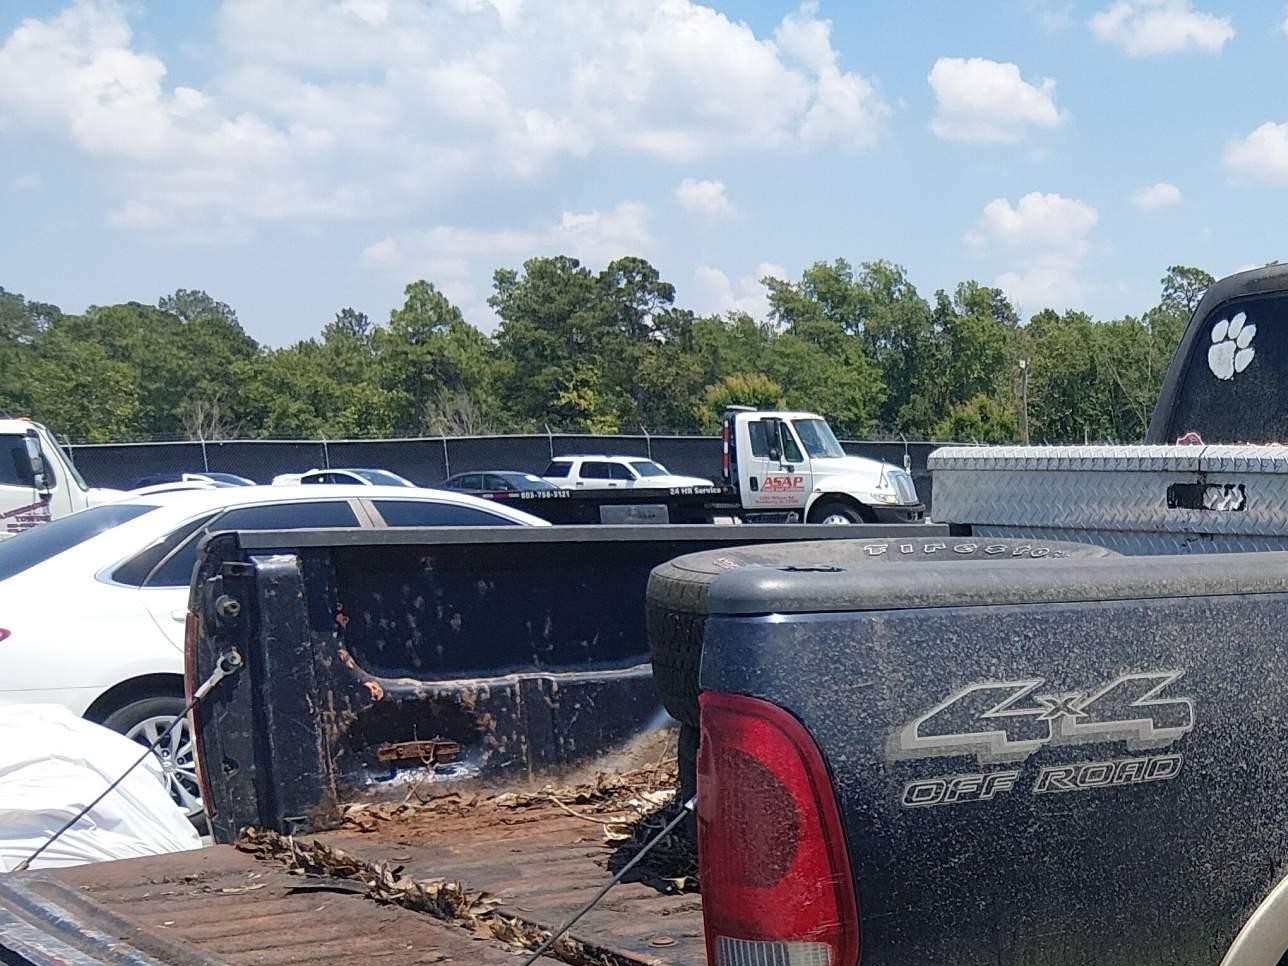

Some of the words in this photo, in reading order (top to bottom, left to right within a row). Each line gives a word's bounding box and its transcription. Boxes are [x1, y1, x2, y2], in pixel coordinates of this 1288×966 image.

[761, 476, 804, 489] ASAP
[694, 487, 722, 495] Service
[902, 770, 1021, 808] OFF
[1033, 754, 1184, 793] ROAD
